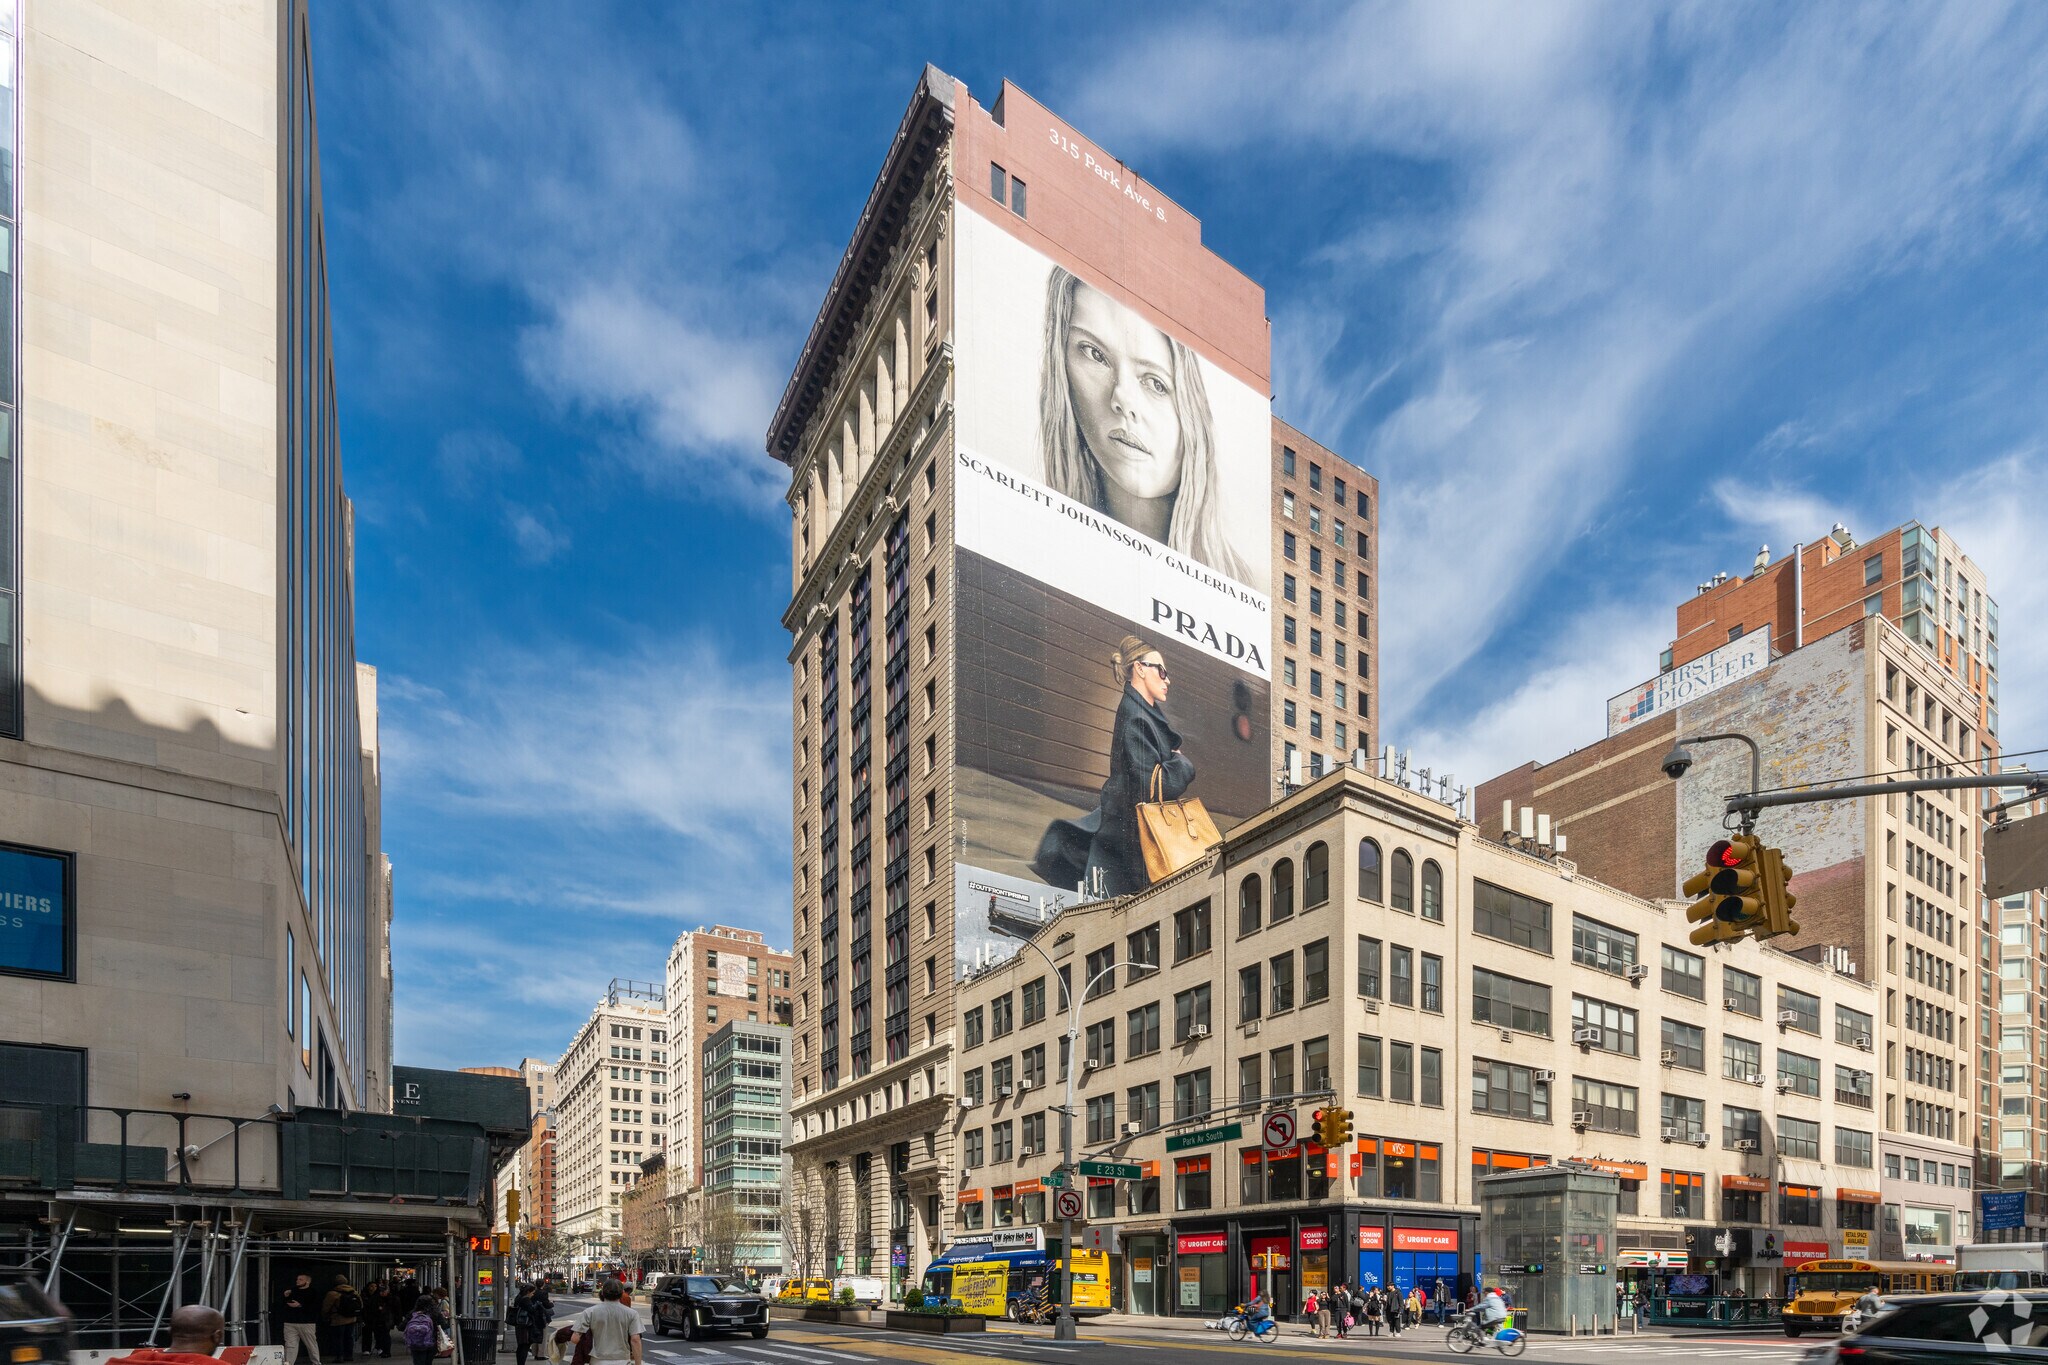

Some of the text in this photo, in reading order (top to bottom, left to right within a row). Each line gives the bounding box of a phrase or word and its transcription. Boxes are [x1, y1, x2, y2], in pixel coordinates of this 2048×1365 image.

[1049, 128, 1167, 223] 315 Park Ave. S.
[959, 453, 1053, 507] SCARLETT
[1057, 503, 1152, 557] JOHANSSON
[1165, 555, 1236, 599] GALLERIA
[1240, 591, 1266, 612] BAG
[1151, 597, 1266, 671] PRADA
[1658, 651, 1720, 691] FIRST
[1658, 652, 1757, 708] PIONEER
[0, 892, 51, 913] IERS
[969, 882, 1029, 901] #OUTFRONTPRIME
[1183, 1131, 1223, 1146] Park Av South
[1097, 1164, 1125, 1176] E 23 St
[1003, 1232, 1015, 1242] Spicy
[1015, 1231, 1024, 1240] Hot
[1025, 1231, 1033, 1239] Pot
